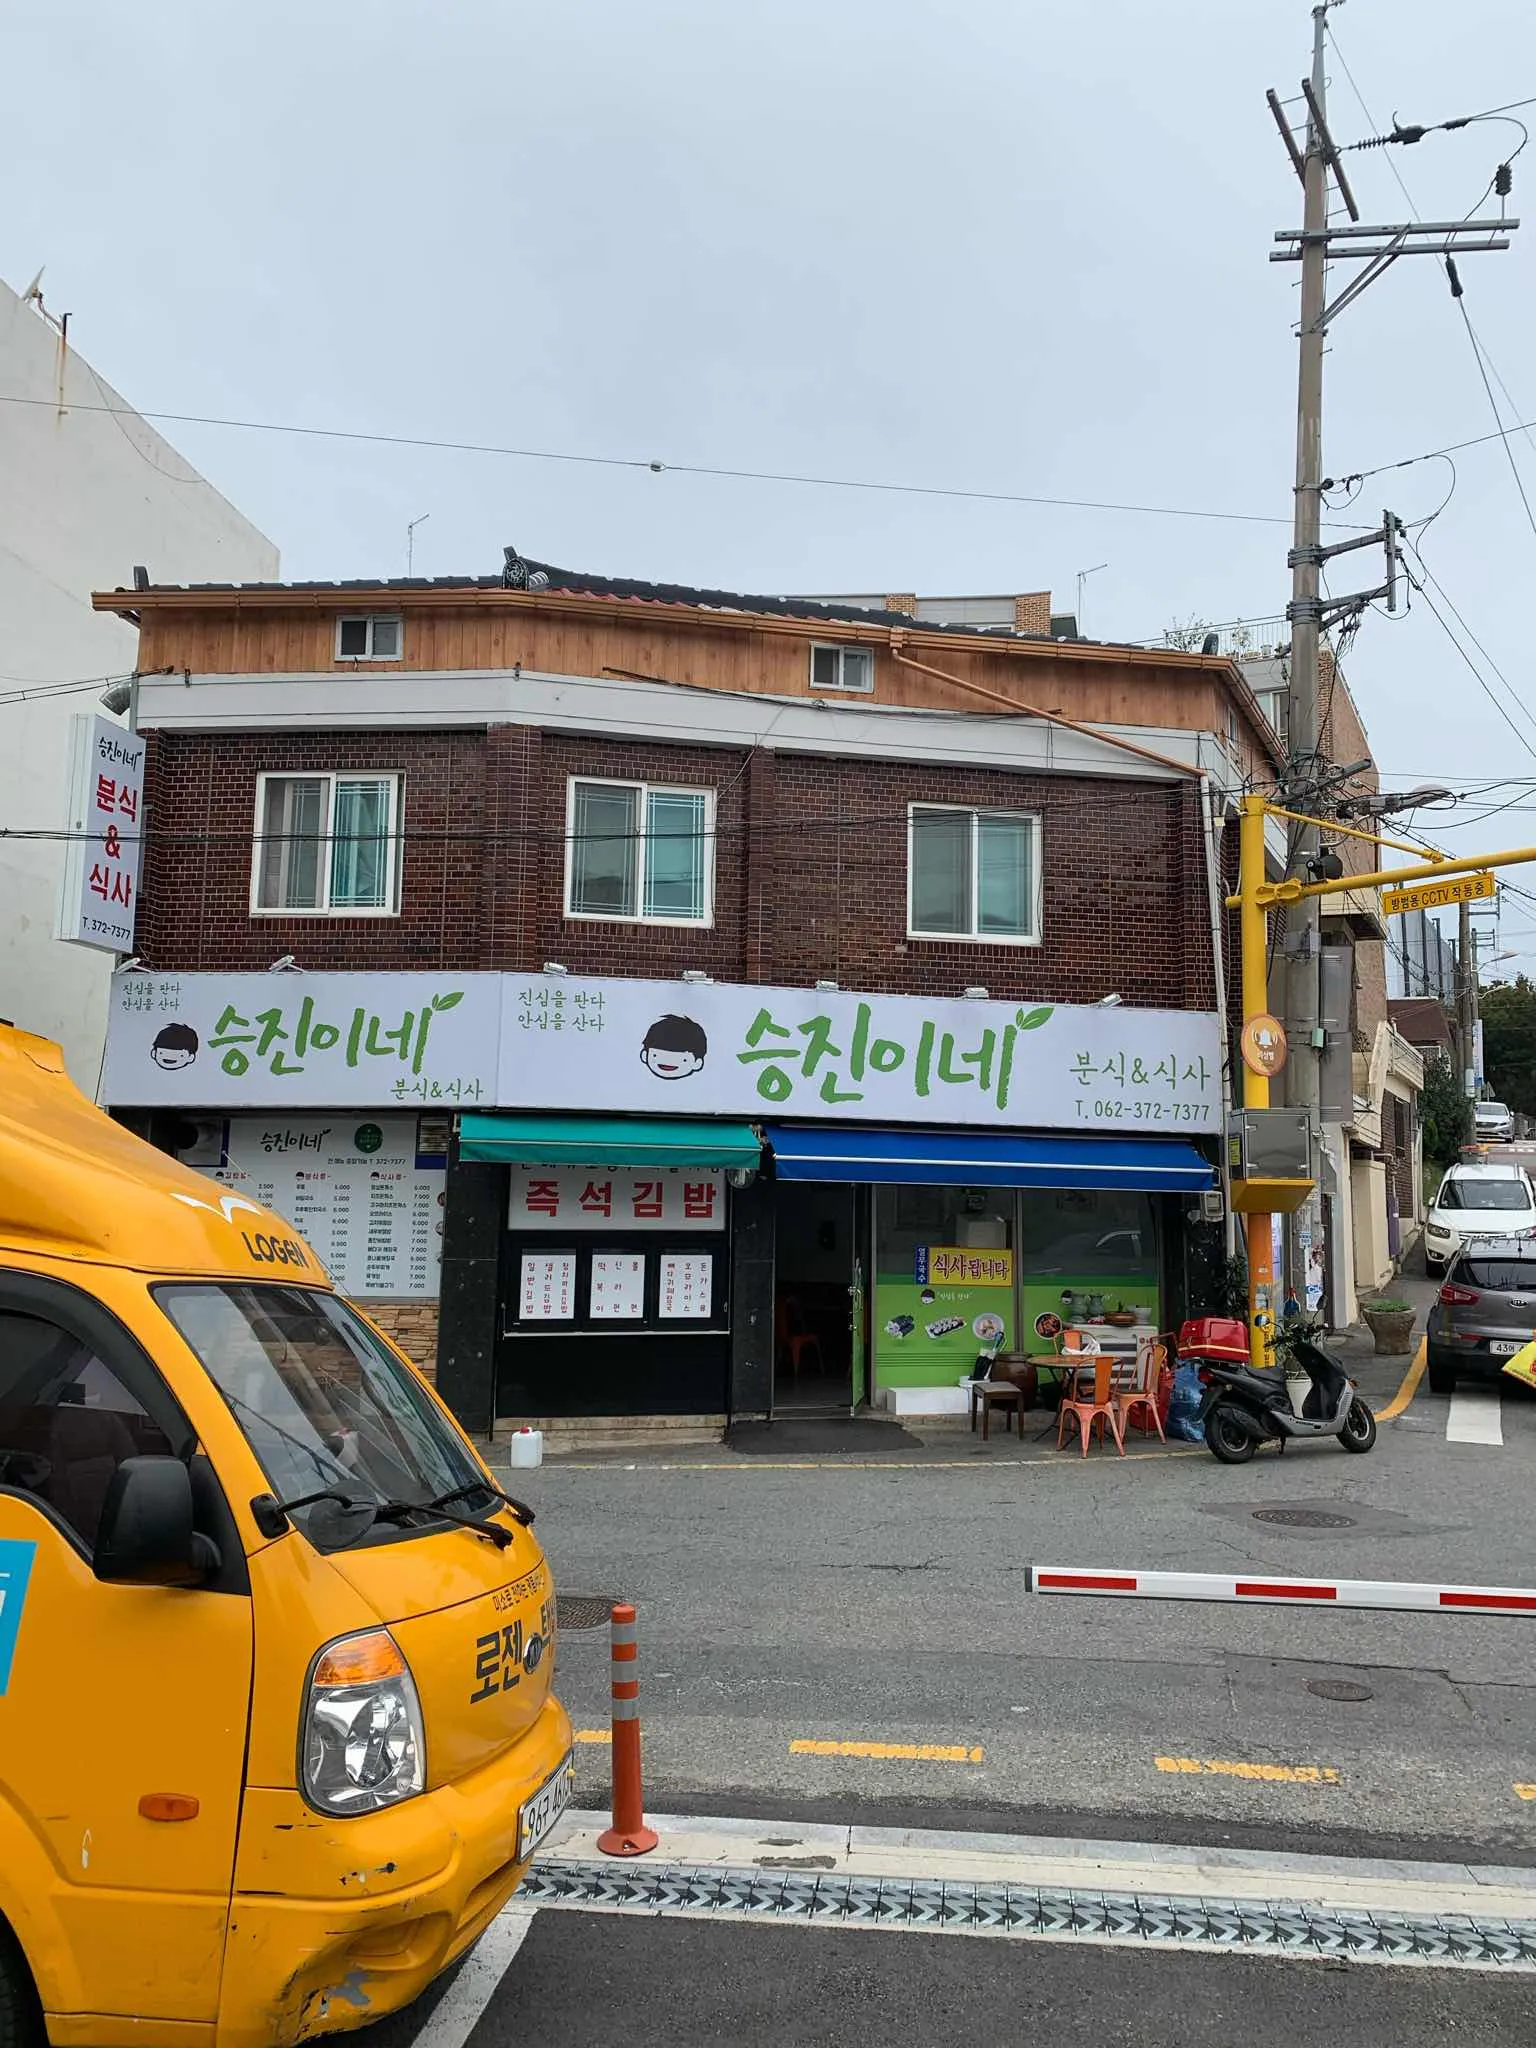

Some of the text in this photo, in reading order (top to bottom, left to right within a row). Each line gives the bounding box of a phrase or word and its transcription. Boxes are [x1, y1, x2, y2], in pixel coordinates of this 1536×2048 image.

[98, 736, 139, 772] 승진이네
[96, 774, 137, 822] 분식
[105, 824, 120, 859] &
[89, 863, 132, 908] 식사
[1421, 888, 1449, 906] CCTV
[1452, 881, 1485, 898] 작동중
[122, 981, 182, 996] 진심을 판다
[122, 998, 181, 1012] 안심을 산다
[518, 989, 606, 1010] 진심을 판다
[207, 996, 433, 1076] 승진이네
[518, 1011, 605, 1032] 안심을 산다
[736, 1003, 1017, 1111] 승진이네
[260, 1130, 324, 1152] 승진이네
[525, 1181, 717, 1219] 즉석김밥
[241, 1231, 310, 1268] LOGEN
[526, 1262, 536, 1314] 일반김밥
[469, 1618, 523, 1705] 로젠
[528, 1794, 550, 1845] 96구
